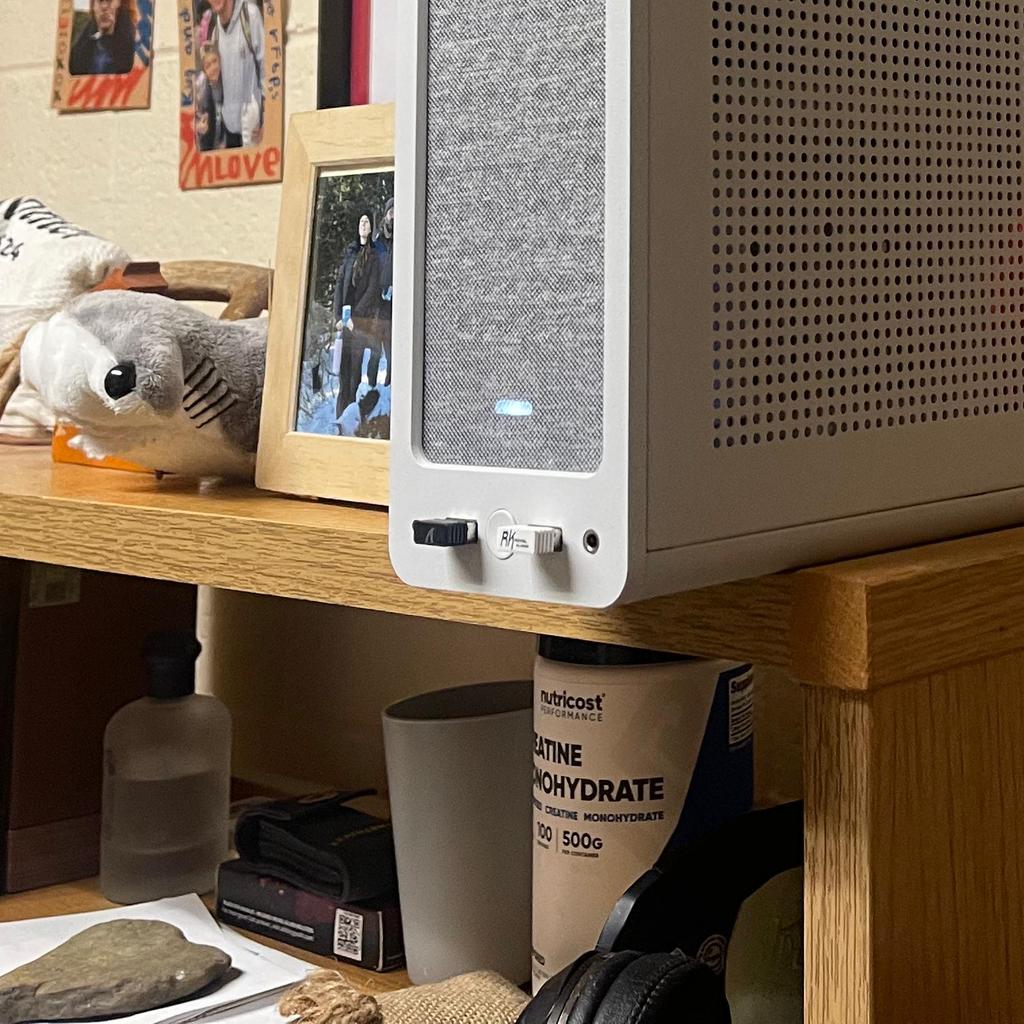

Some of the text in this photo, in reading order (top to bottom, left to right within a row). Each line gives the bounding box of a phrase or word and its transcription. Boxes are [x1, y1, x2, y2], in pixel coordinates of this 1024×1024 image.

[540, 690, 603, 711] nutricost
[540, 705, 604, 722] PERFORMANCE
[545, 805, 664, 823] CREATINE MONOHYDRATE
[537, 821, 552, 842] 100
